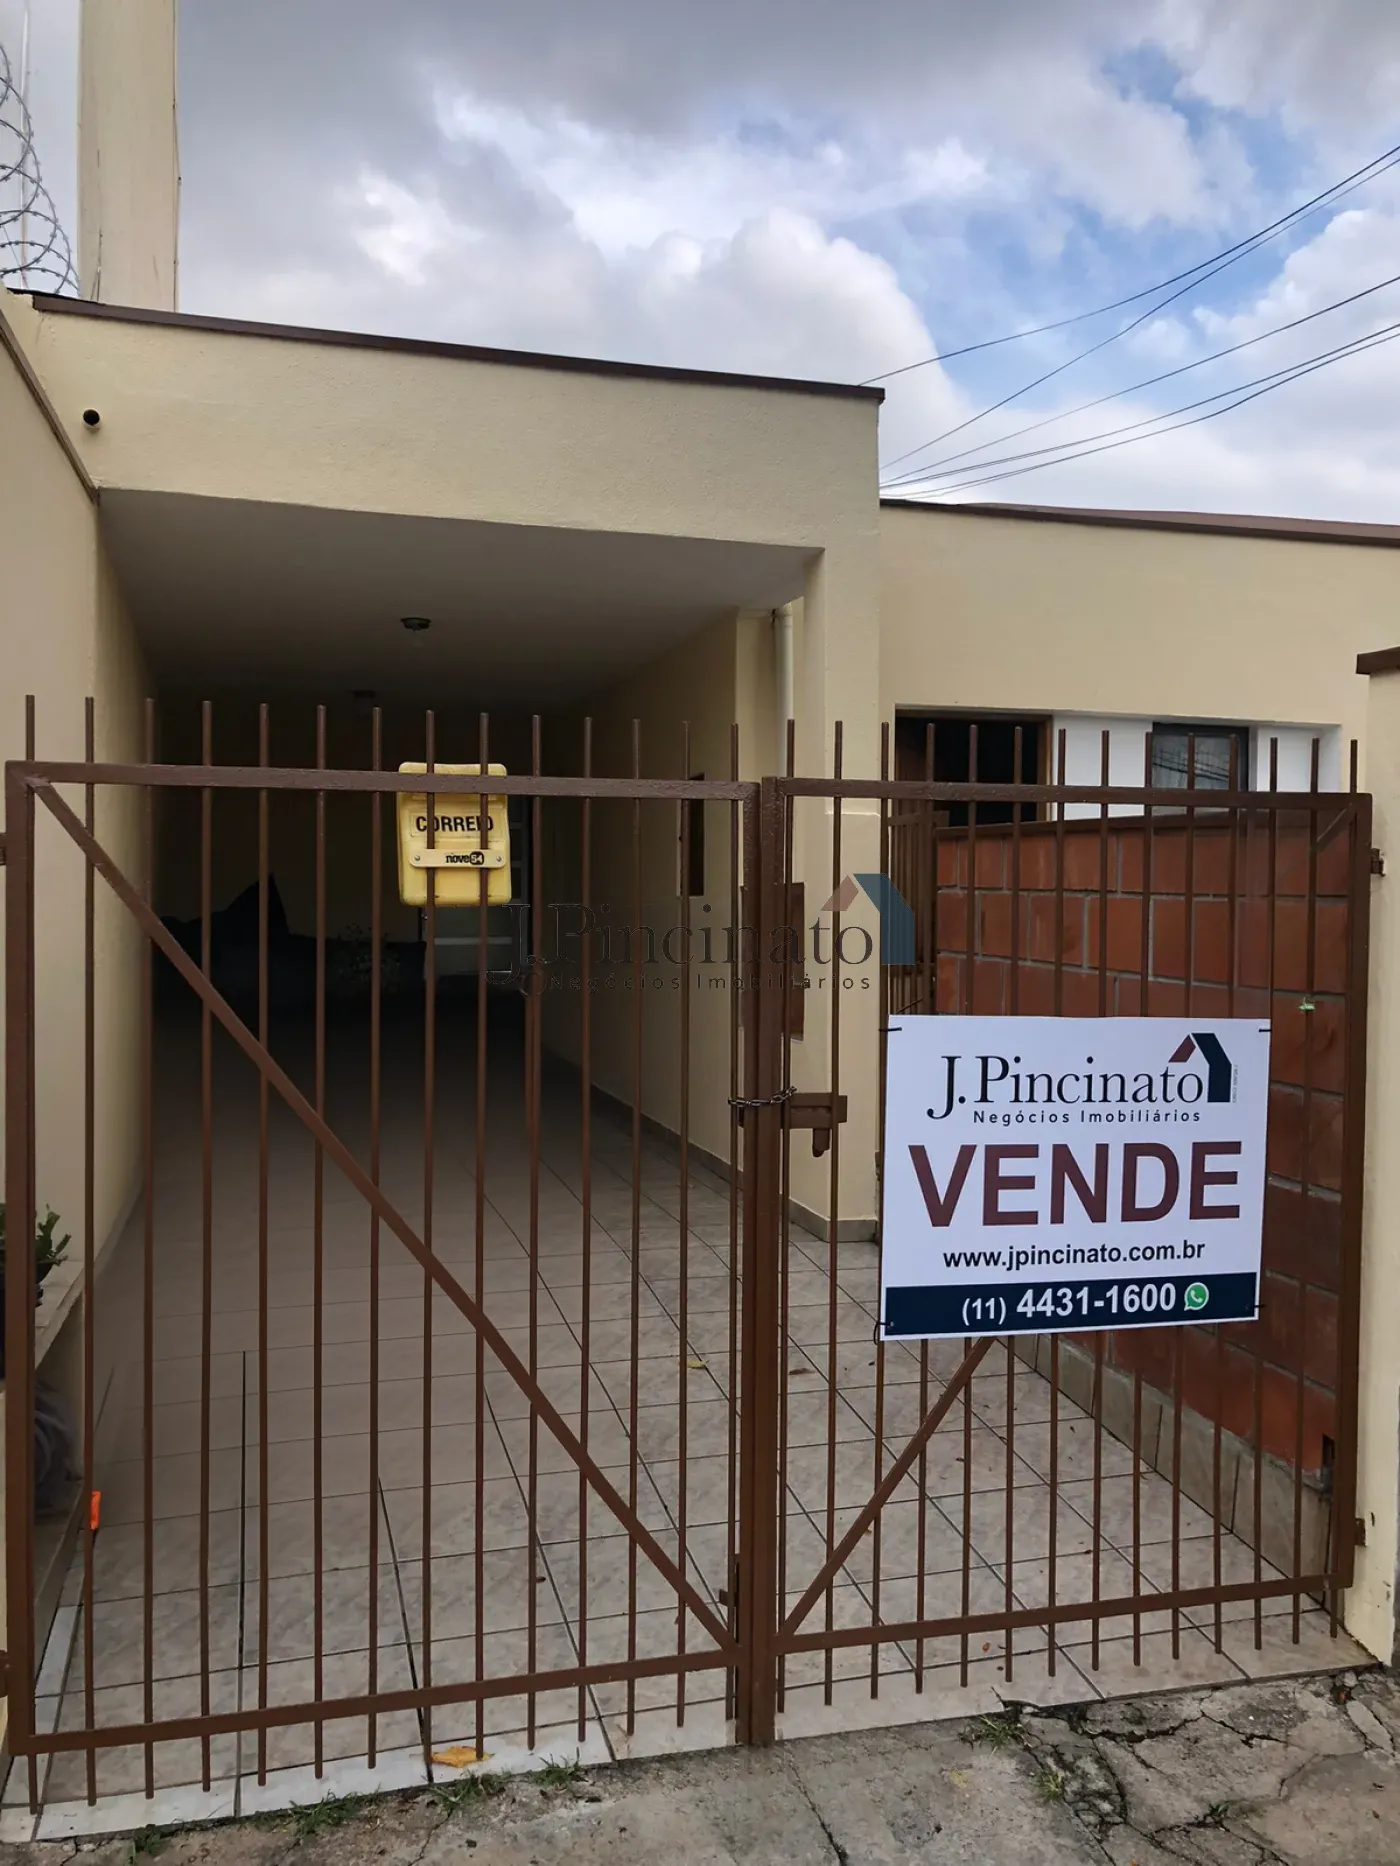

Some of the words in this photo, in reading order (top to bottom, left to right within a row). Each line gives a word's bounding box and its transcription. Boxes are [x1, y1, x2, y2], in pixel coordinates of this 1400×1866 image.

[973, 1110, 1069, 1127] Negócios
[1081, 1109, 1200, 1123] Imobiliários
[908, 1141, 1242, 1227] VENDE
[943, 1240, 1205, 1271] www.jpincinato.com.br
[962, 1297, 1006, 1325] (11)
[1016, 1282, 1176, 1318] 4431-1600
